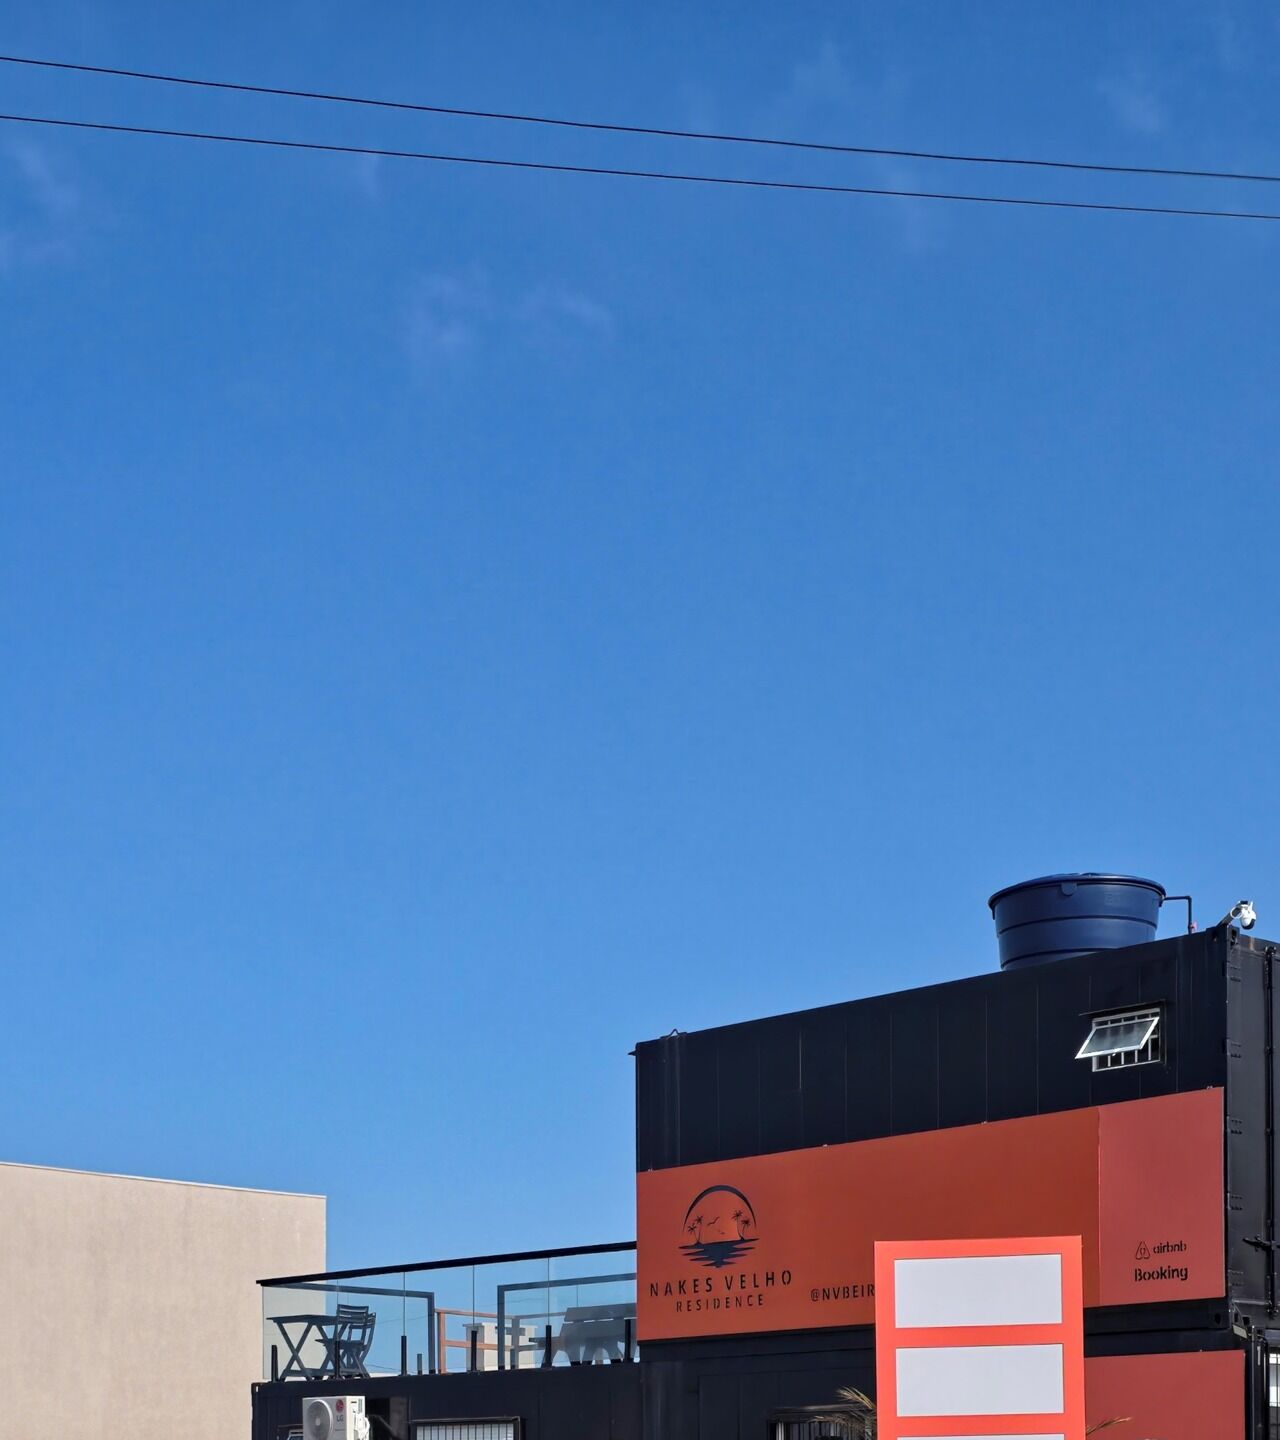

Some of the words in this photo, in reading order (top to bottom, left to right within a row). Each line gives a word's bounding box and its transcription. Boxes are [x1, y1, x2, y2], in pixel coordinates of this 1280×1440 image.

[1153, 1240, 1187, 1254] airbnb
[1134, 1265, 1188, 1282] Booking
[650, 1277, 713, 1297] NAKES
[724, 1270, 792, 1291] VELHO
[676, 1294, 764, 1313] RESIDENCE
[336, 1414, 344, 1422] LG
